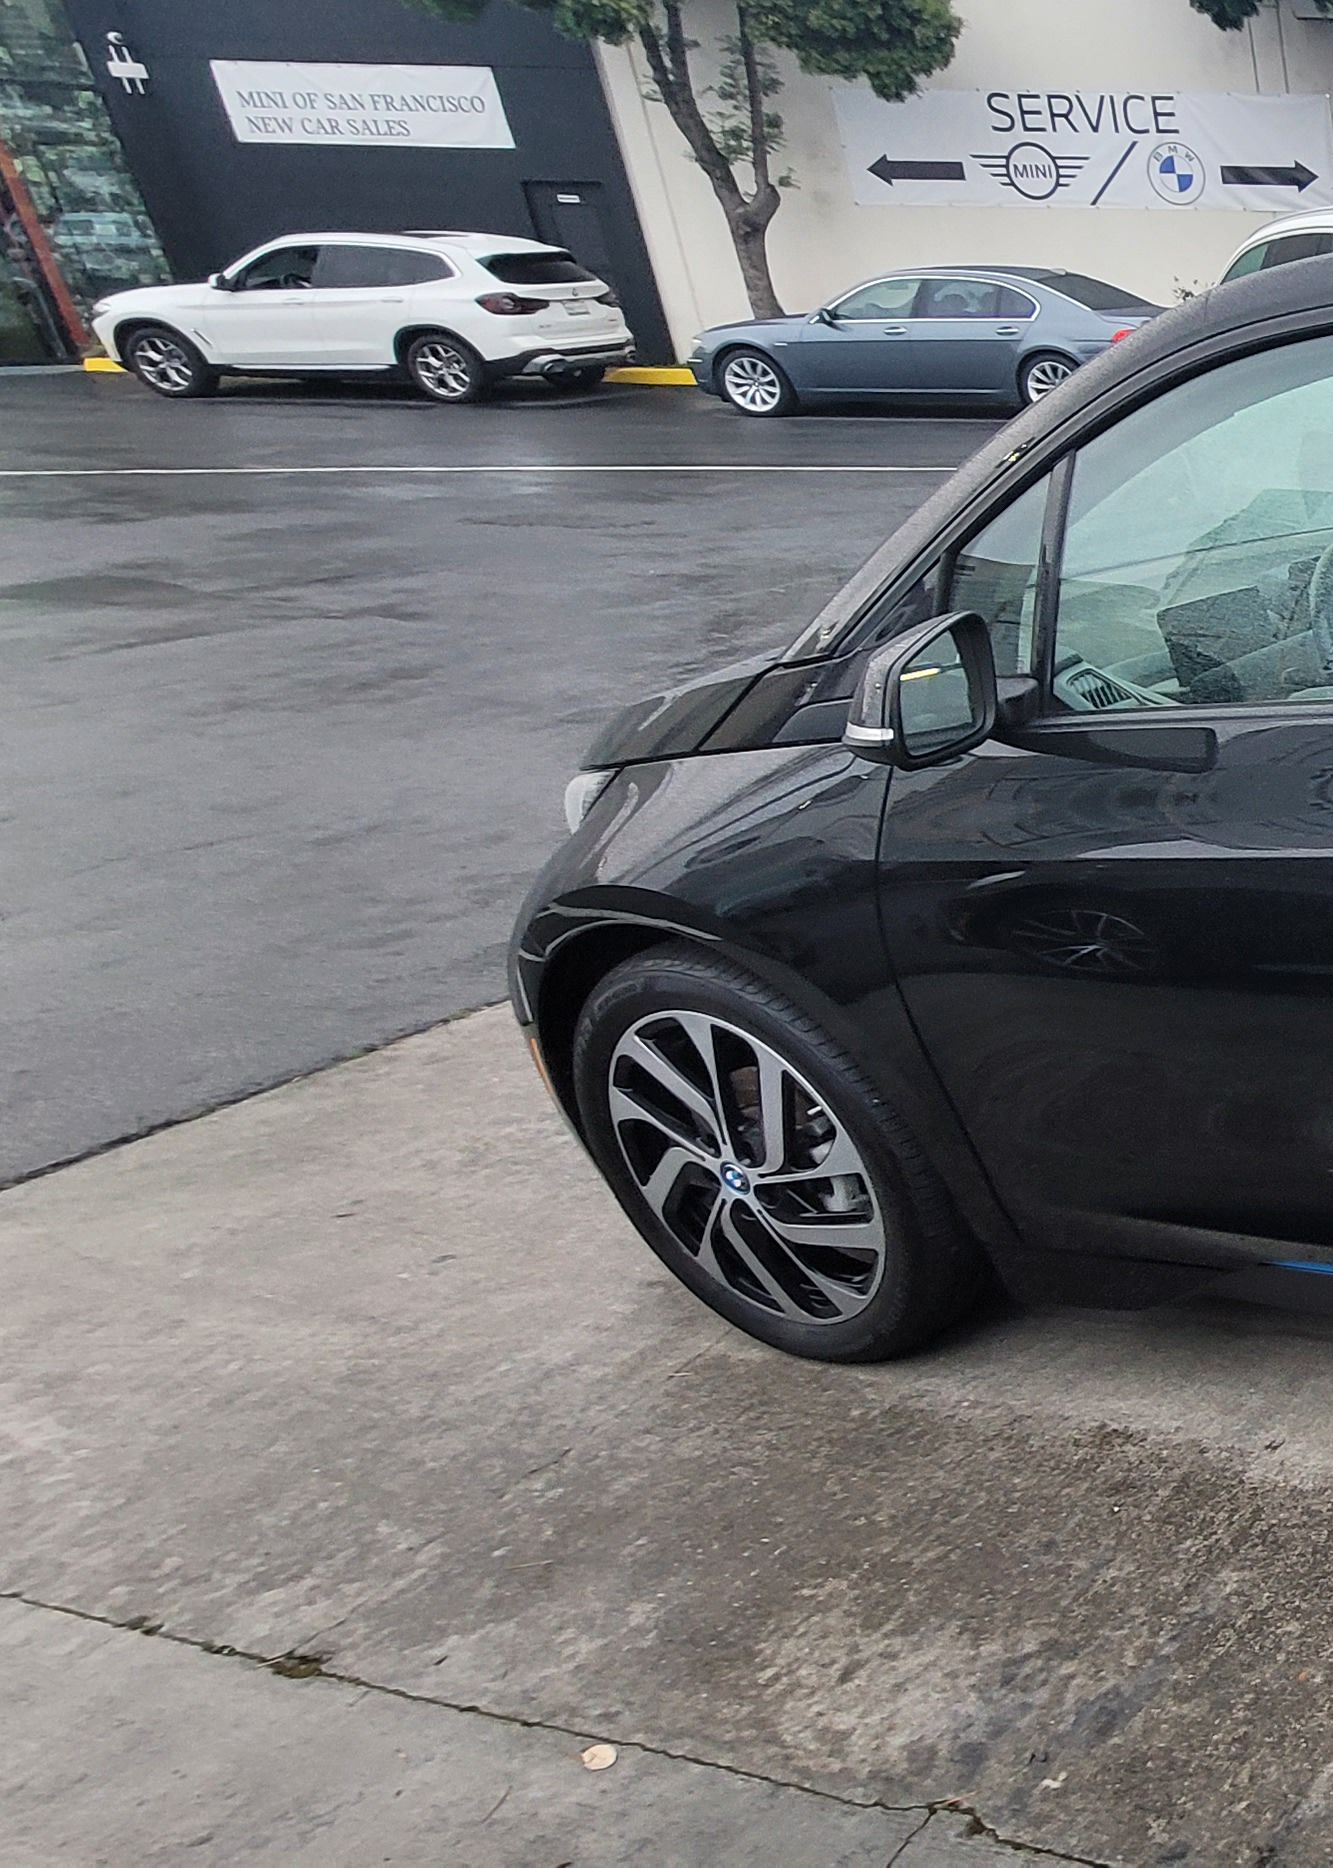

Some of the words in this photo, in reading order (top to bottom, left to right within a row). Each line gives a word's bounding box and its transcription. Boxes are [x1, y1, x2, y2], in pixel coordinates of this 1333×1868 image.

[235, 90, 287, 110] MINI
[294, 92, 319, 110] OF
[324, 92, 366, 112] SAN
[369, 94, 486, 114] FRANCISCO
[986, 92, 1180, 134] SERVICE
[245, 115, 294, 135] NEW
[302, 118, 343, 136] CAR
[349, 119, 411, 137] SALES
[1153, 145, 1195, 163] BMW
[1012, 163, 1053, 180] MINI
